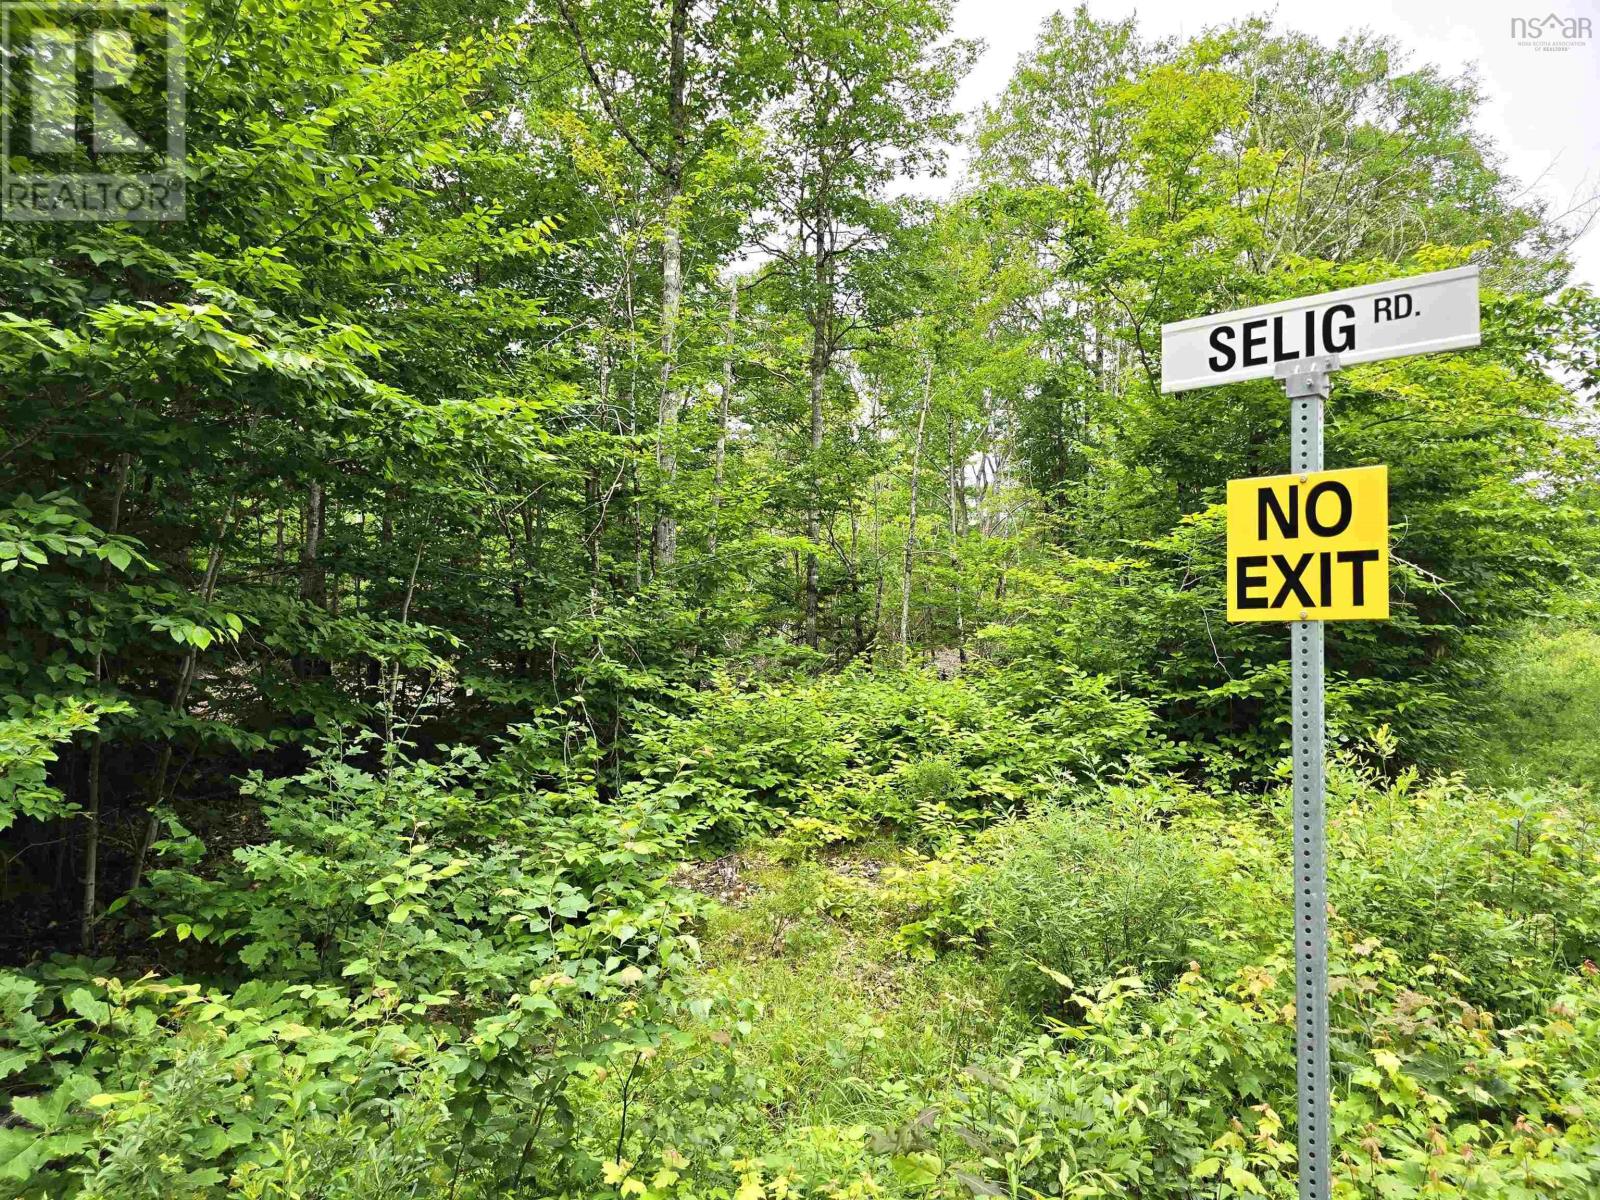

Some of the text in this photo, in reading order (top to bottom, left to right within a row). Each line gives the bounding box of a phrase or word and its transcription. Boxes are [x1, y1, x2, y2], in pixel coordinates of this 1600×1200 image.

[1209, 293, 1421, 372] SELIG RD.
[1258, 480, 1352, 541] NO
[1237, 549, 1379, 610] EXIT
